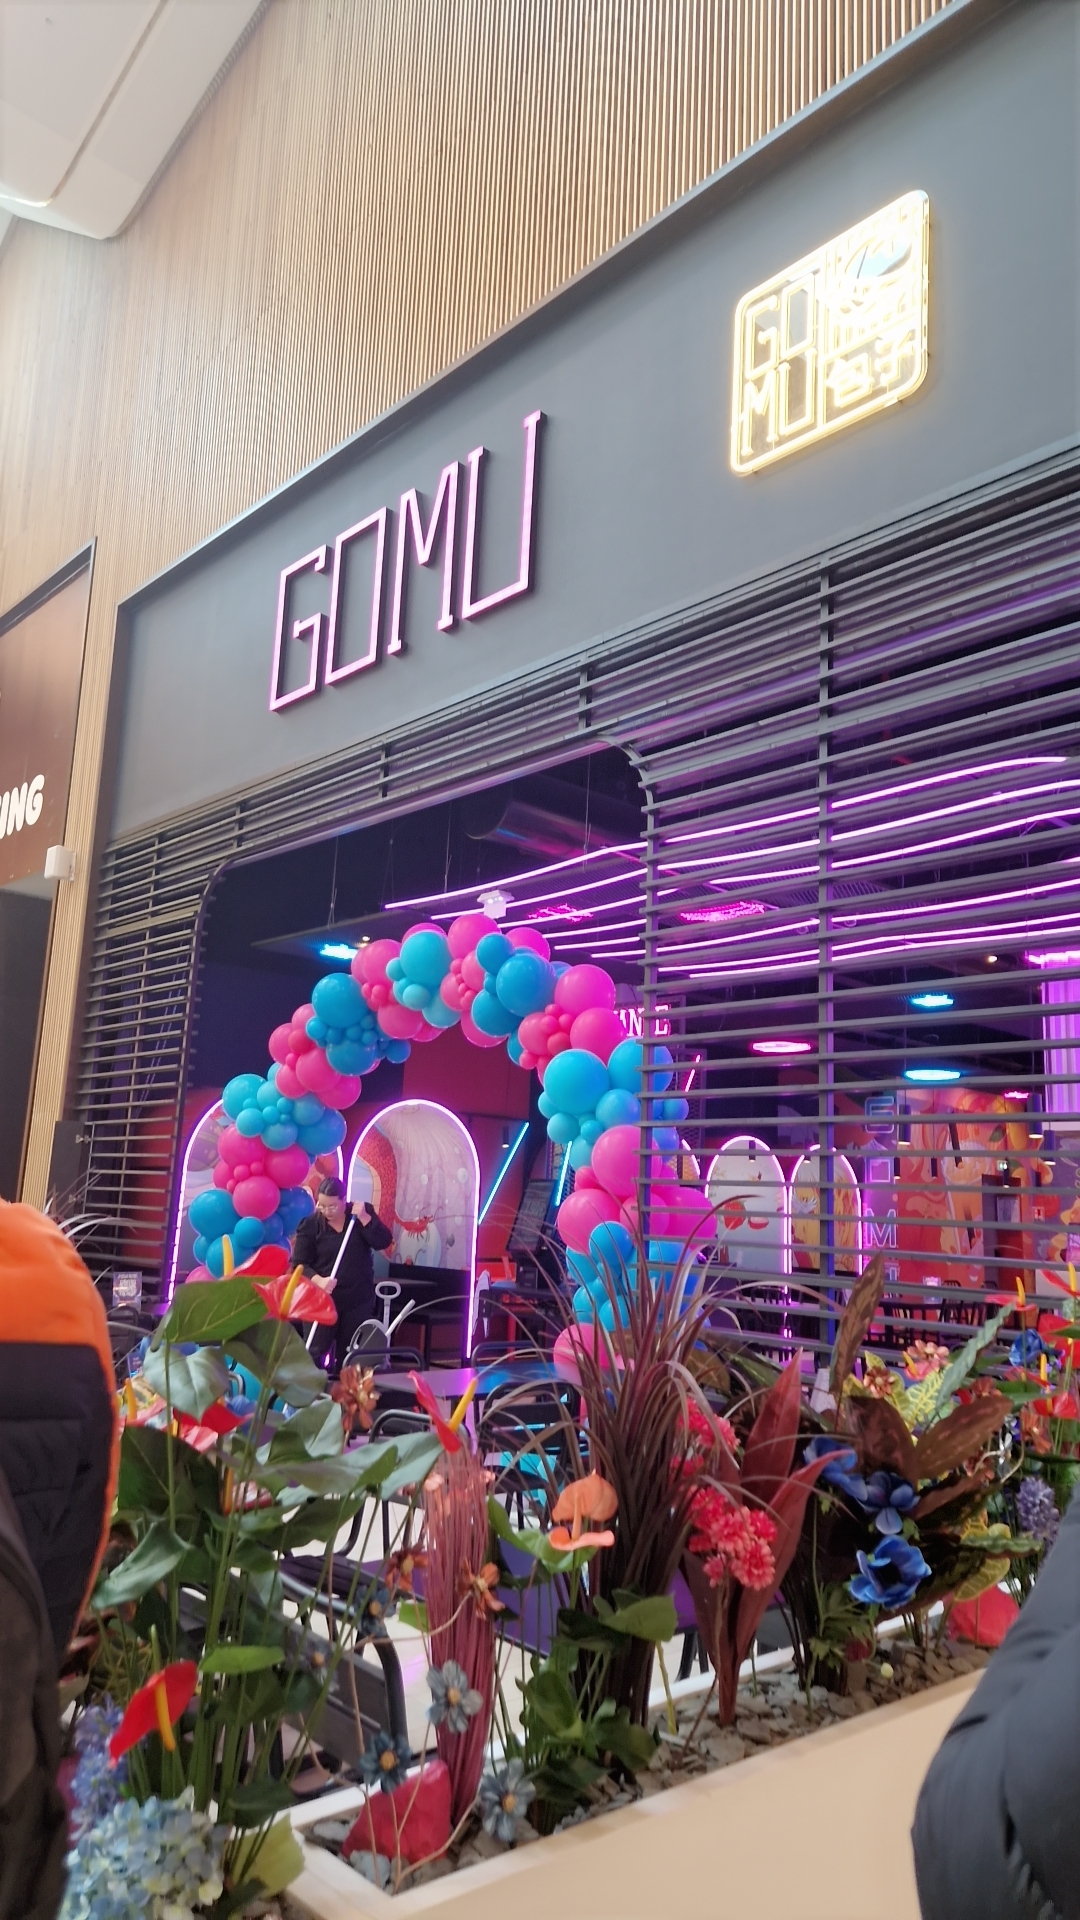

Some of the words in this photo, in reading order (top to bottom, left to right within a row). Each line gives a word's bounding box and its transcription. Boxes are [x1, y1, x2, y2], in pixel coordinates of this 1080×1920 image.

[744, 272, 816, 380] GO
[741, 345, 818, 456] MU
[269, 409, 542, 711] GOMU
[0, 773, 45, 840] ING
